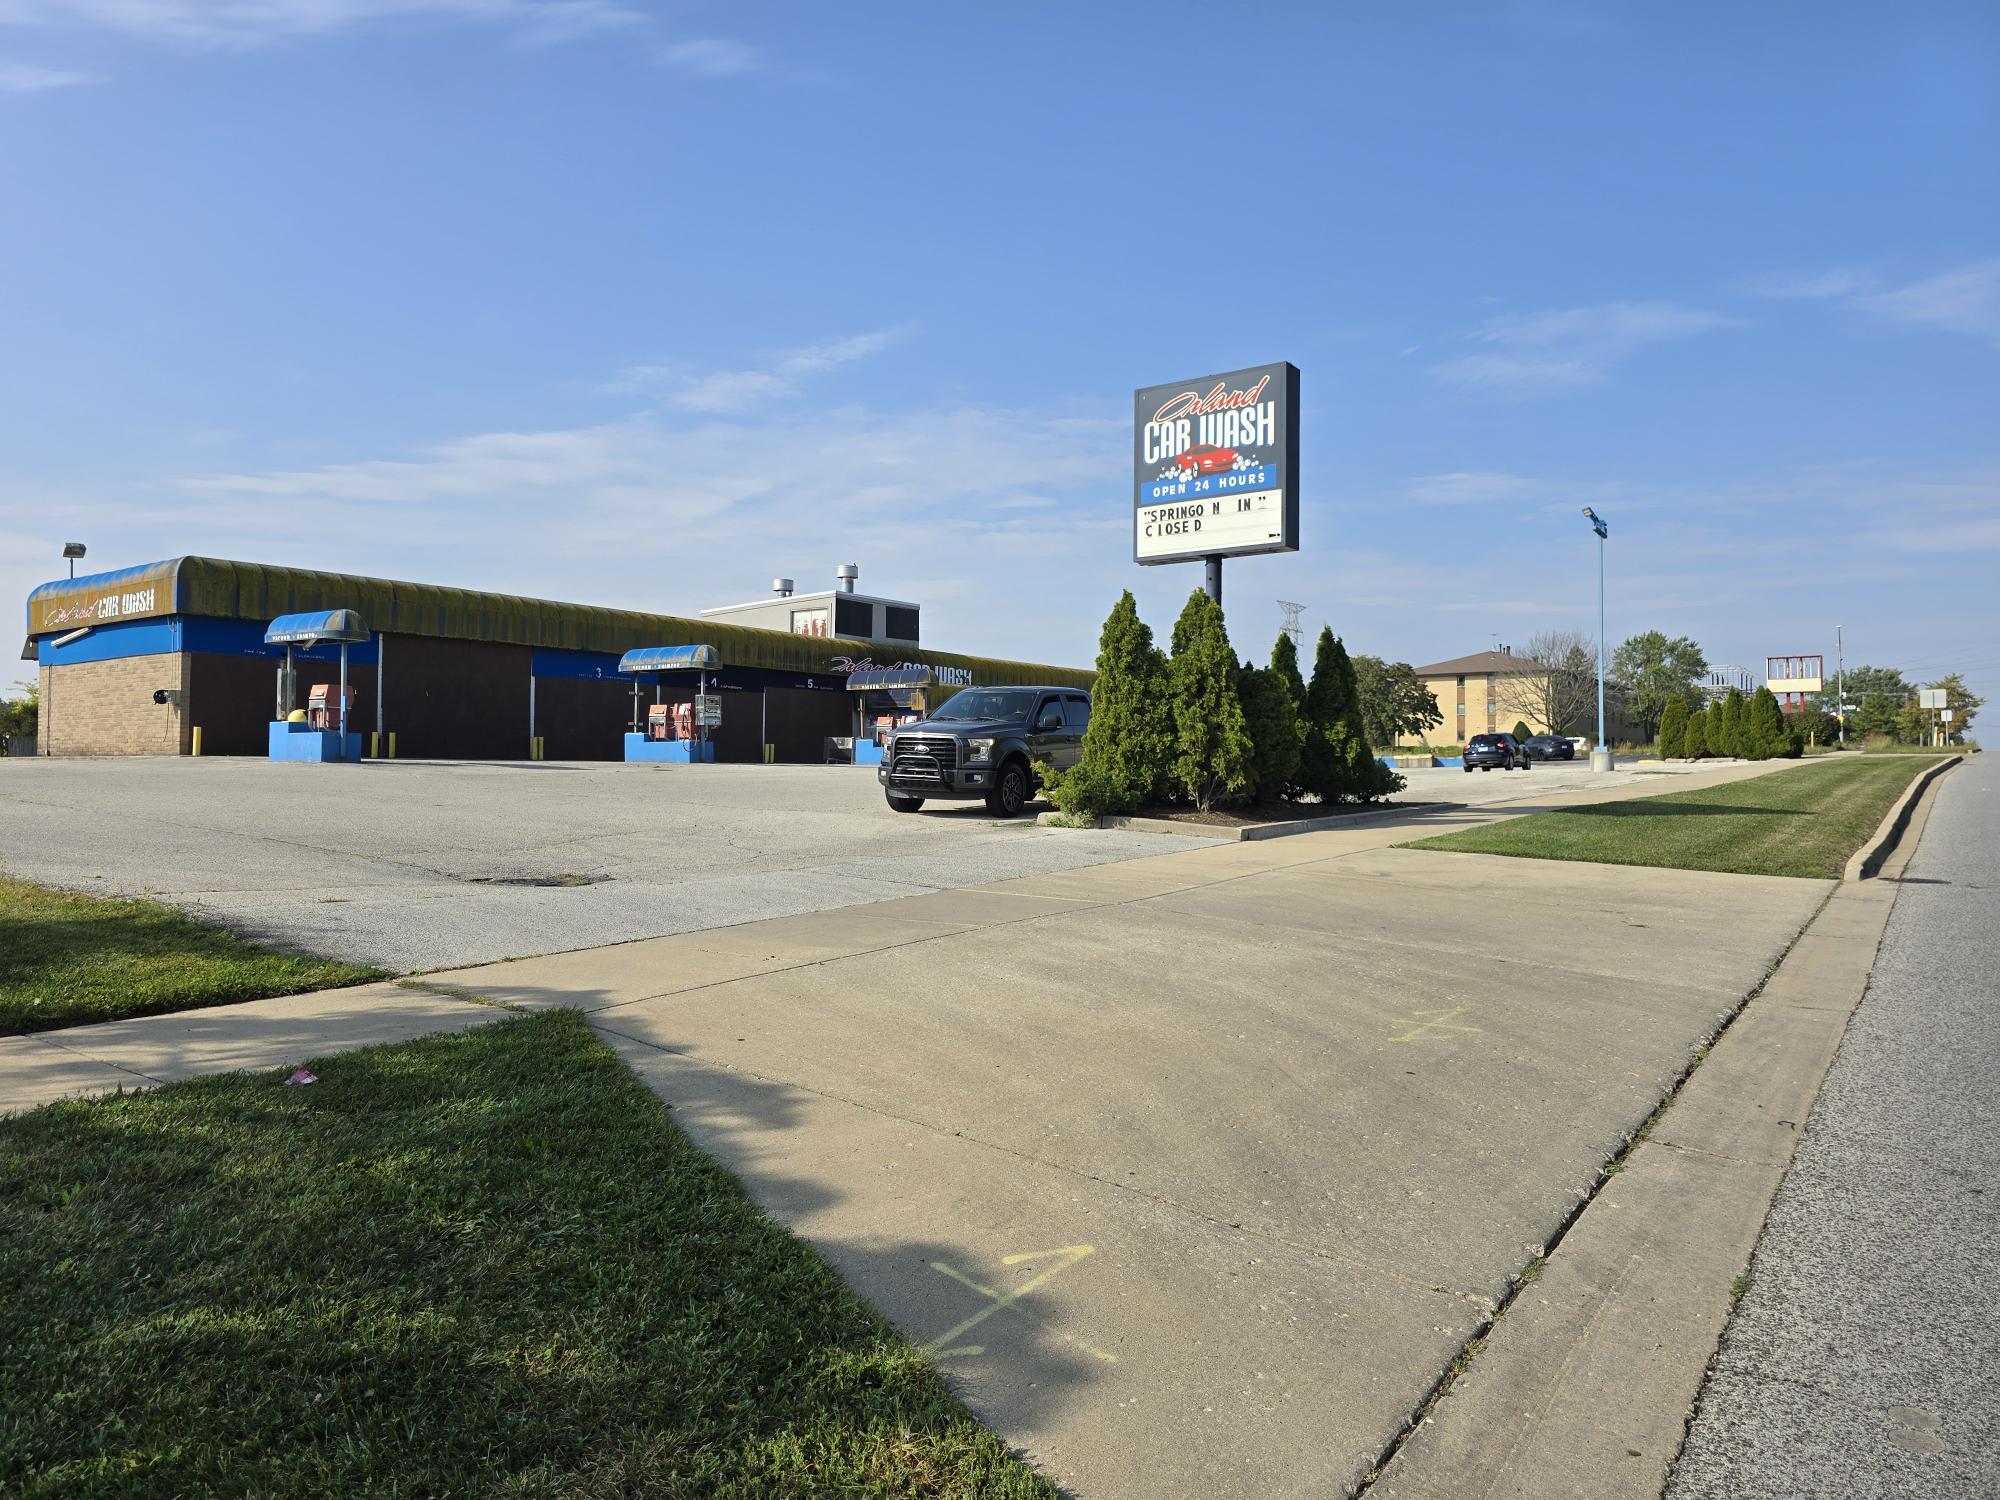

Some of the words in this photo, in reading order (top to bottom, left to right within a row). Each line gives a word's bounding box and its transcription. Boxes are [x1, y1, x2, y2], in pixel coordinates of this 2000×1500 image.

[1153, 375, 1270, 425] Orland
[1144, 418, 1191, 464] CAR
[1200, 400, 1275, 449] WASH
[1153, 484, 1186, 497] OPEN
[1195, 480, 1210, 491] 24
[1219, 472, 1265, 488] HOURS
[98, 595, 119, 619] CAR
[122, 588, 155, 615] WASH
[596, 667, 602, 679] 3
[807, 678, 814, 689] 5
[934, 664, 973, 686] WASH
